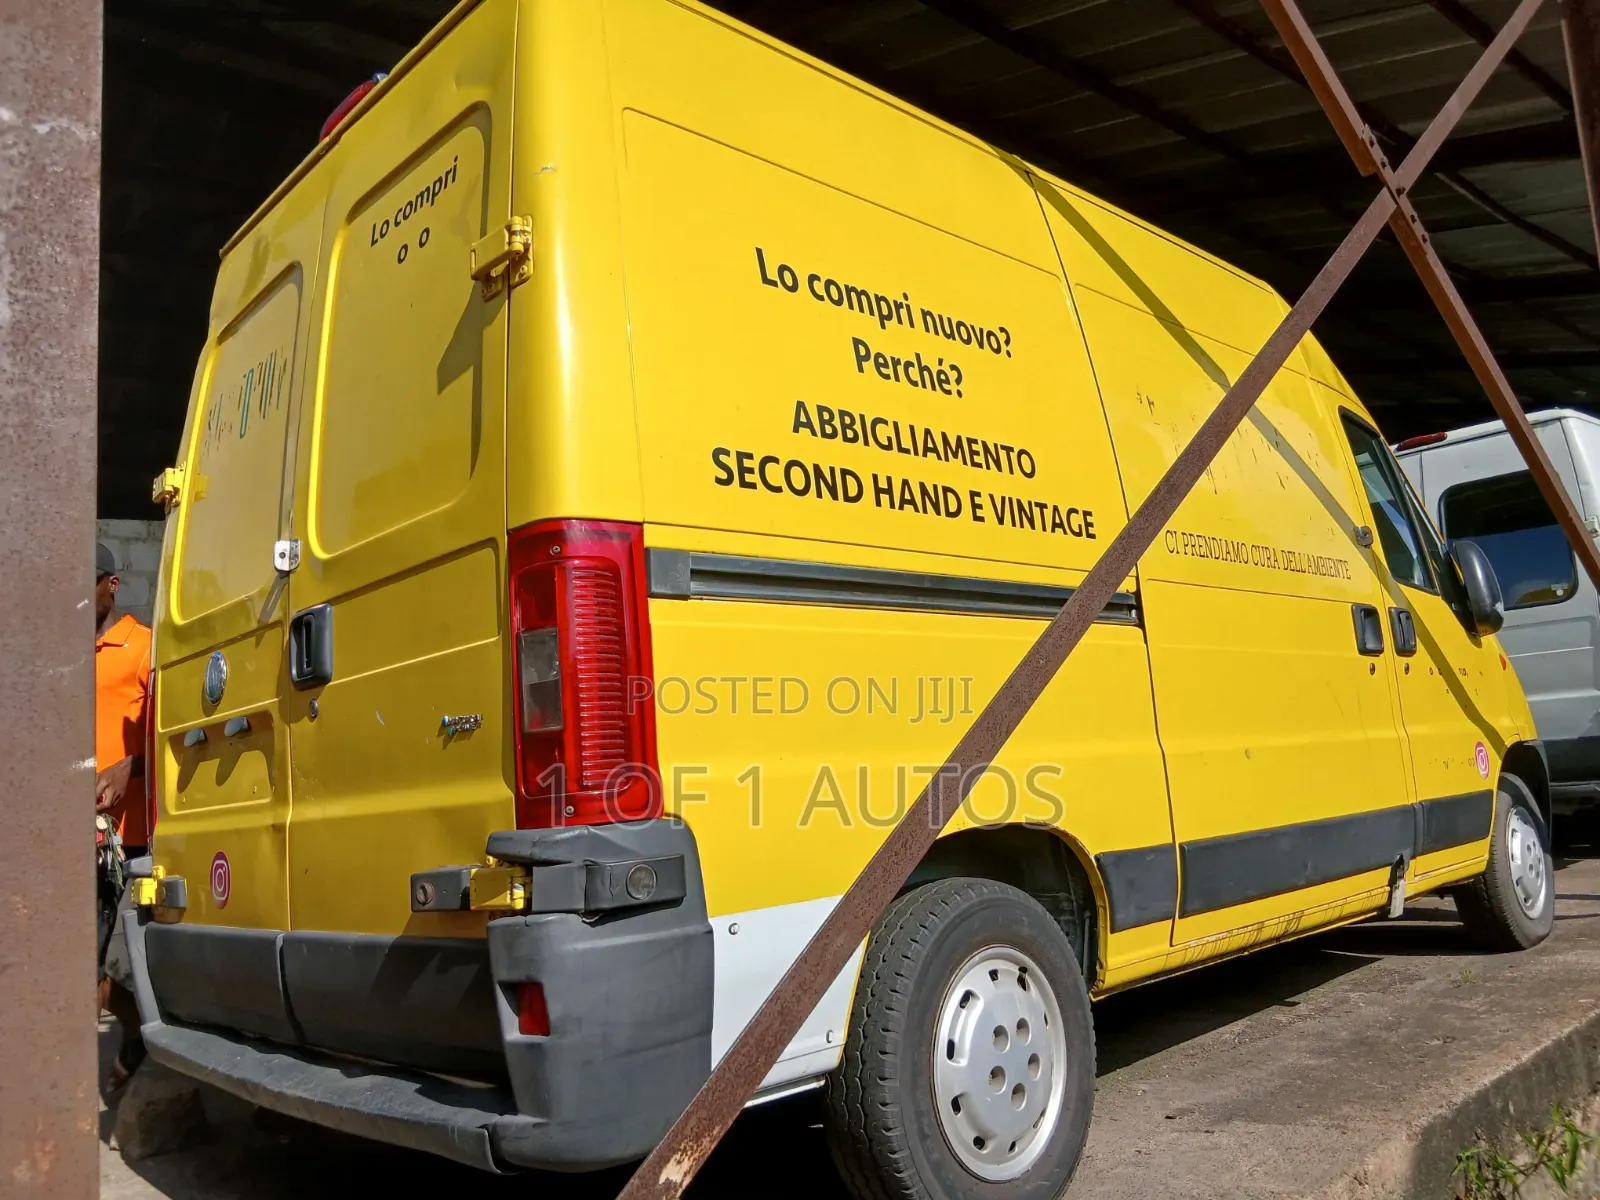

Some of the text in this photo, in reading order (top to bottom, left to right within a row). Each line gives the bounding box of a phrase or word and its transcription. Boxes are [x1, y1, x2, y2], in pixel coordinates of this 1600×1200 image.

[370, 155, 459, 248] Lo compri
[755, 246, 1012, 358] Lo compri nuovo?
[852, 336, 963, 398] Perché?
[792, 400, 1036, 479] ABBIGLIAMENTO
[711, 446, 1097, 540] SECOND HAND E VINTAGE
[1165, 529, 1181, 554] CI
[1182, 532, 1249, 565] PRENDIAMO
[1250, 544, 1281, 570] CURA
